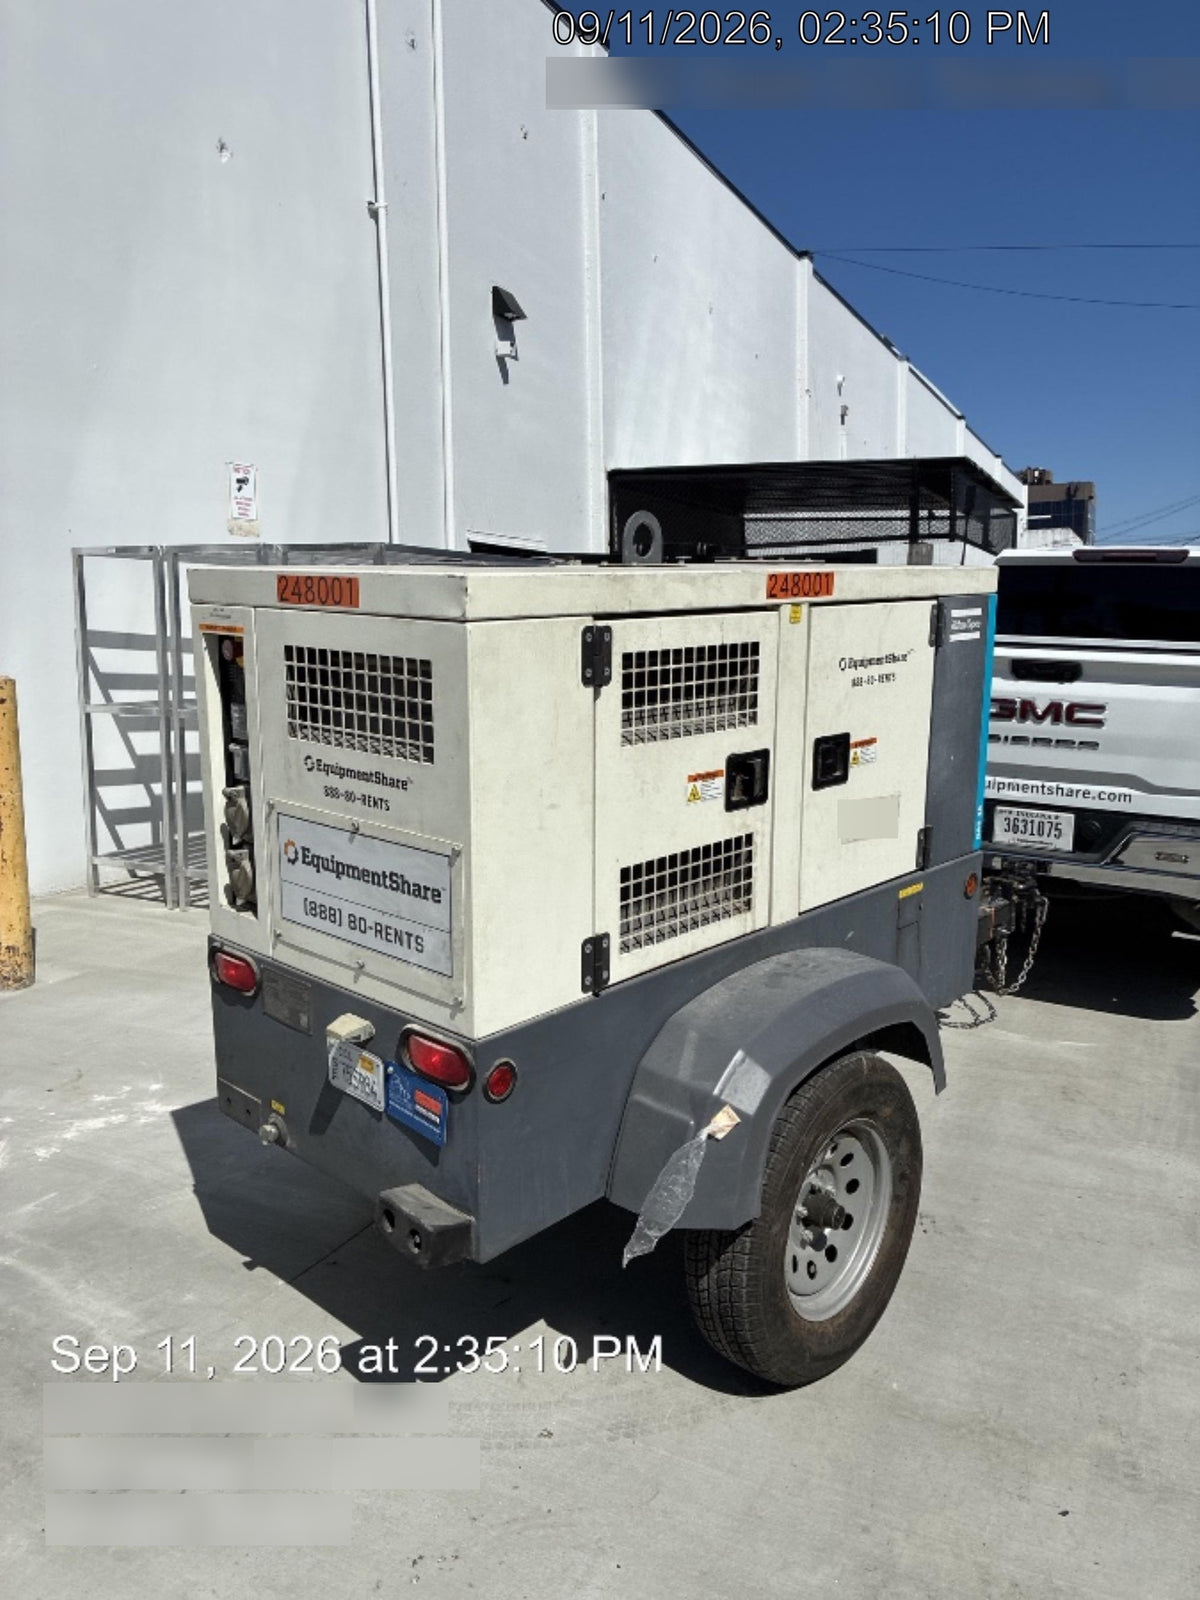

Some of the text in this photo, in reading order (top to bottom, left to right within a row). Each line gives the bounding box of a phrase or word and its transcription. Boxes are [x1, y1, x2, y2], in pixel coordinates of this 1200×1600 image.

[279, 575, 358, 606] 248001
[768, 573, 833, 598] 248001
[988, 697, 1106, 729] GMC
[316, 758, 408, 791] EquipmentShare
[323, 785, 391, 811] 888-80-RENTS
[1003, 817, 1063, 839] 3631075
[301, 846, 442, 904] EquipmentShare
[303, 897, 425, 954] (888) 80-RENTS
